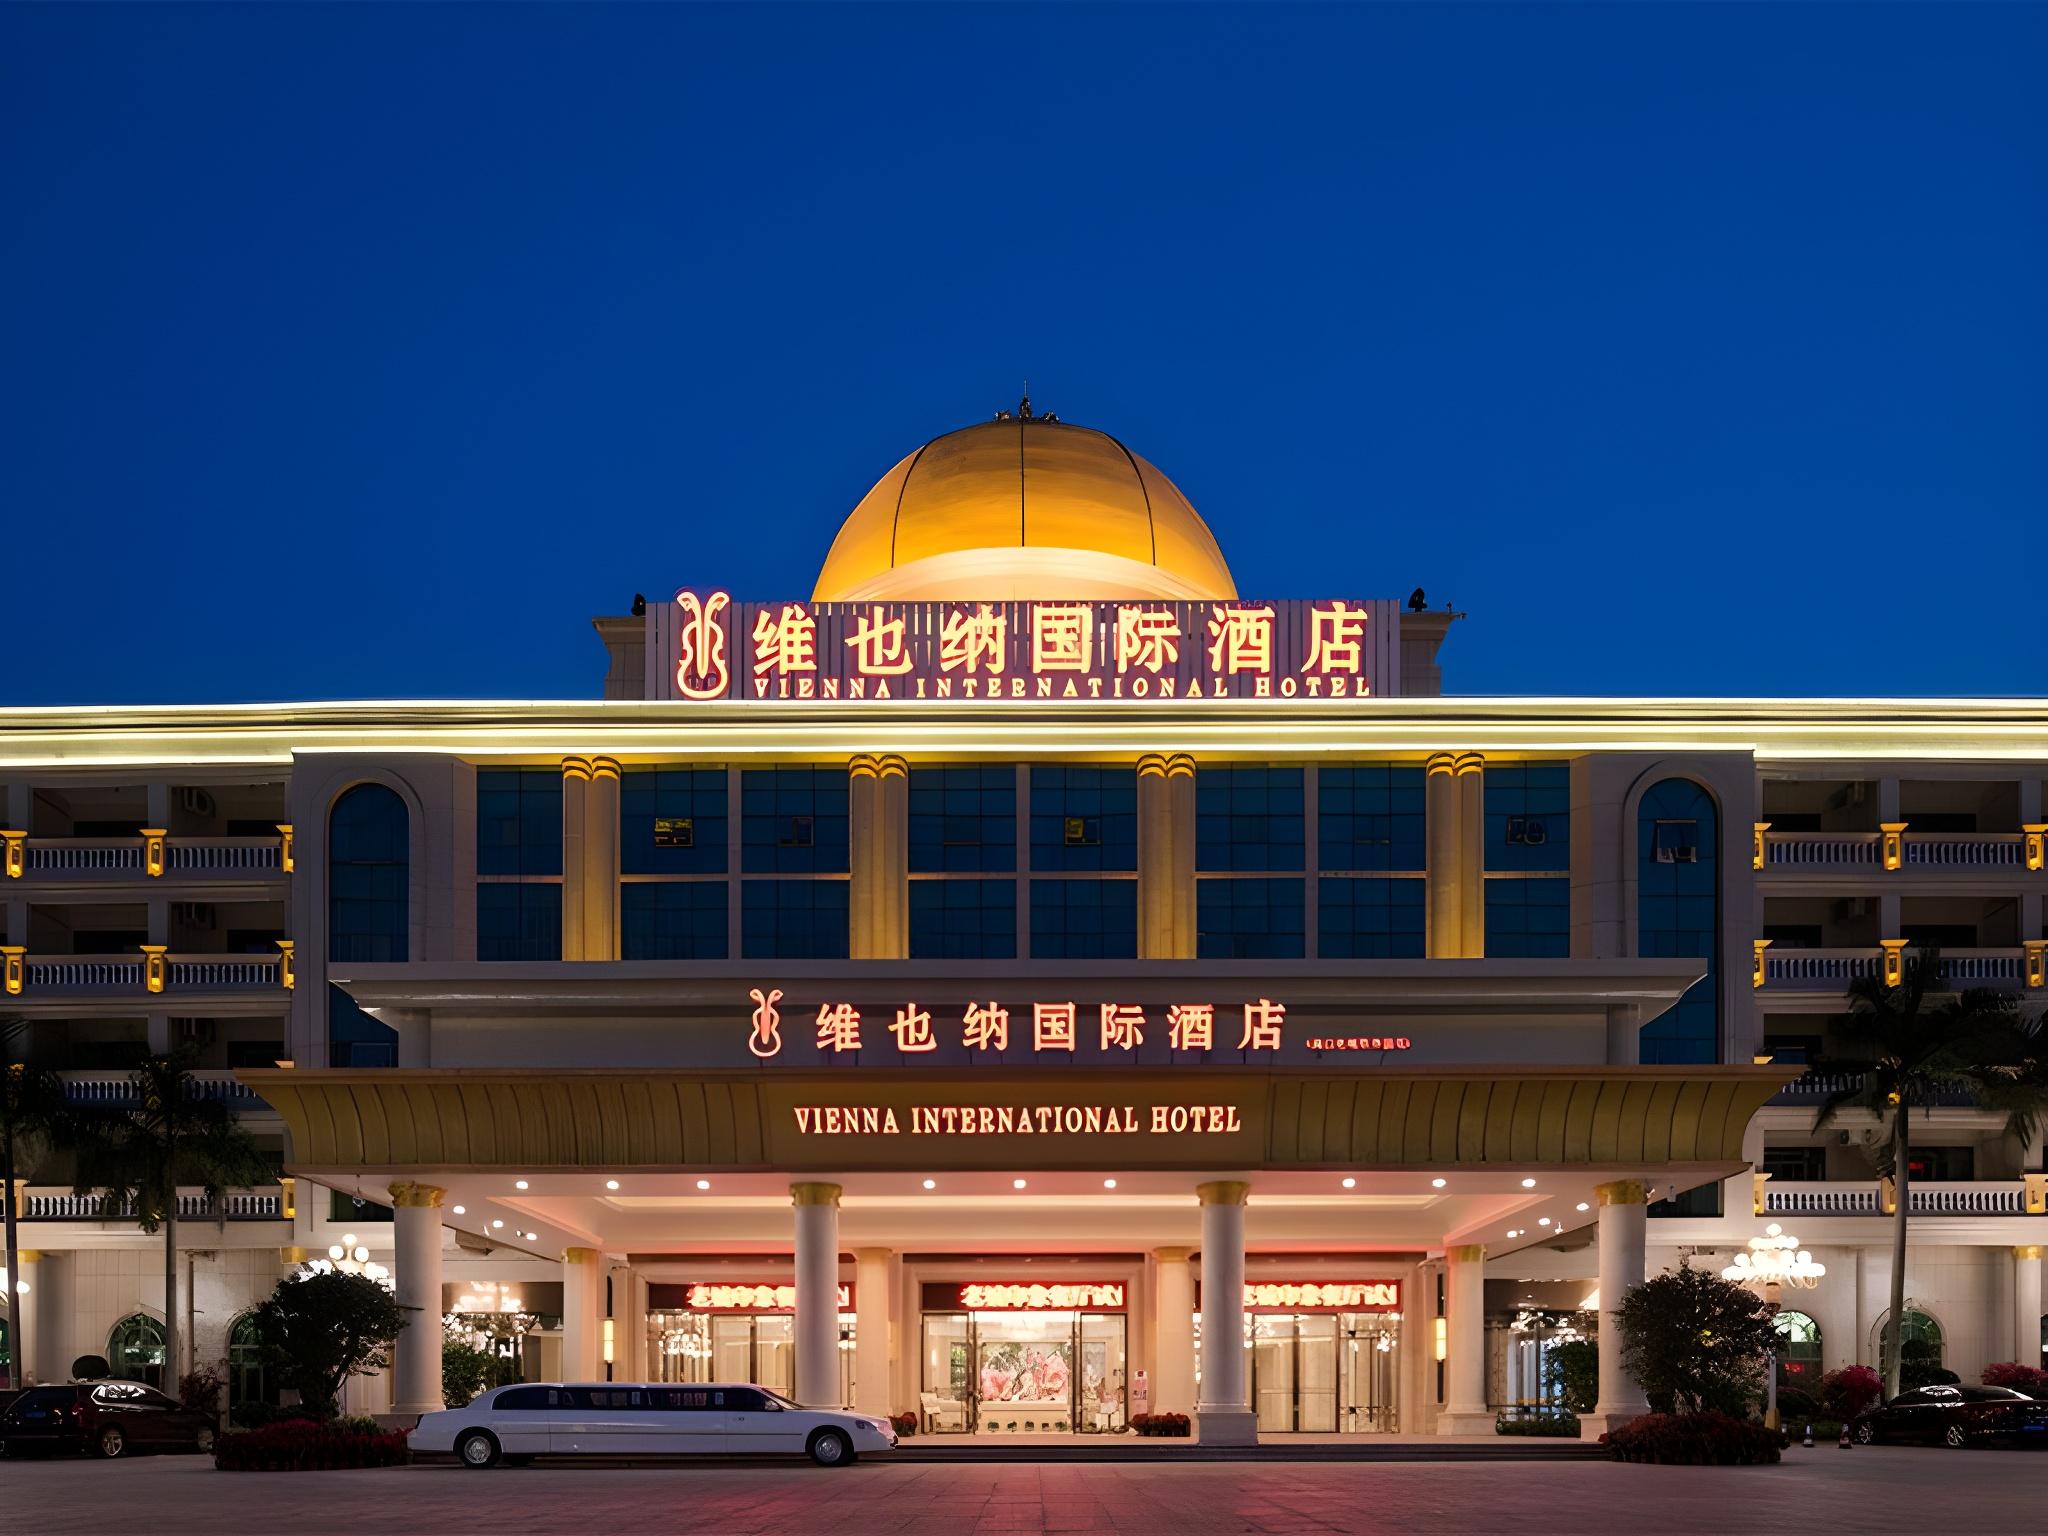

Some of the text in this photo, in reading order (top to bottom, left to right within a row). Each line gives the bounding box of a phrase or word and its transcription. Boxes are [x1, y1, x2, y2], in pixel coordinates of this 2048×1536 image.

[752, 601, 1369, 675] 维也纳国际酒店
[753, 676, 1371, 699] VIENNA INTERNATIONAL HOTEL
[814, 998, 1287, 1052] 维也纳国际酒店
[792, 1106, 1242, 1135] VIENNA INTERNATIONAL HOTEL
